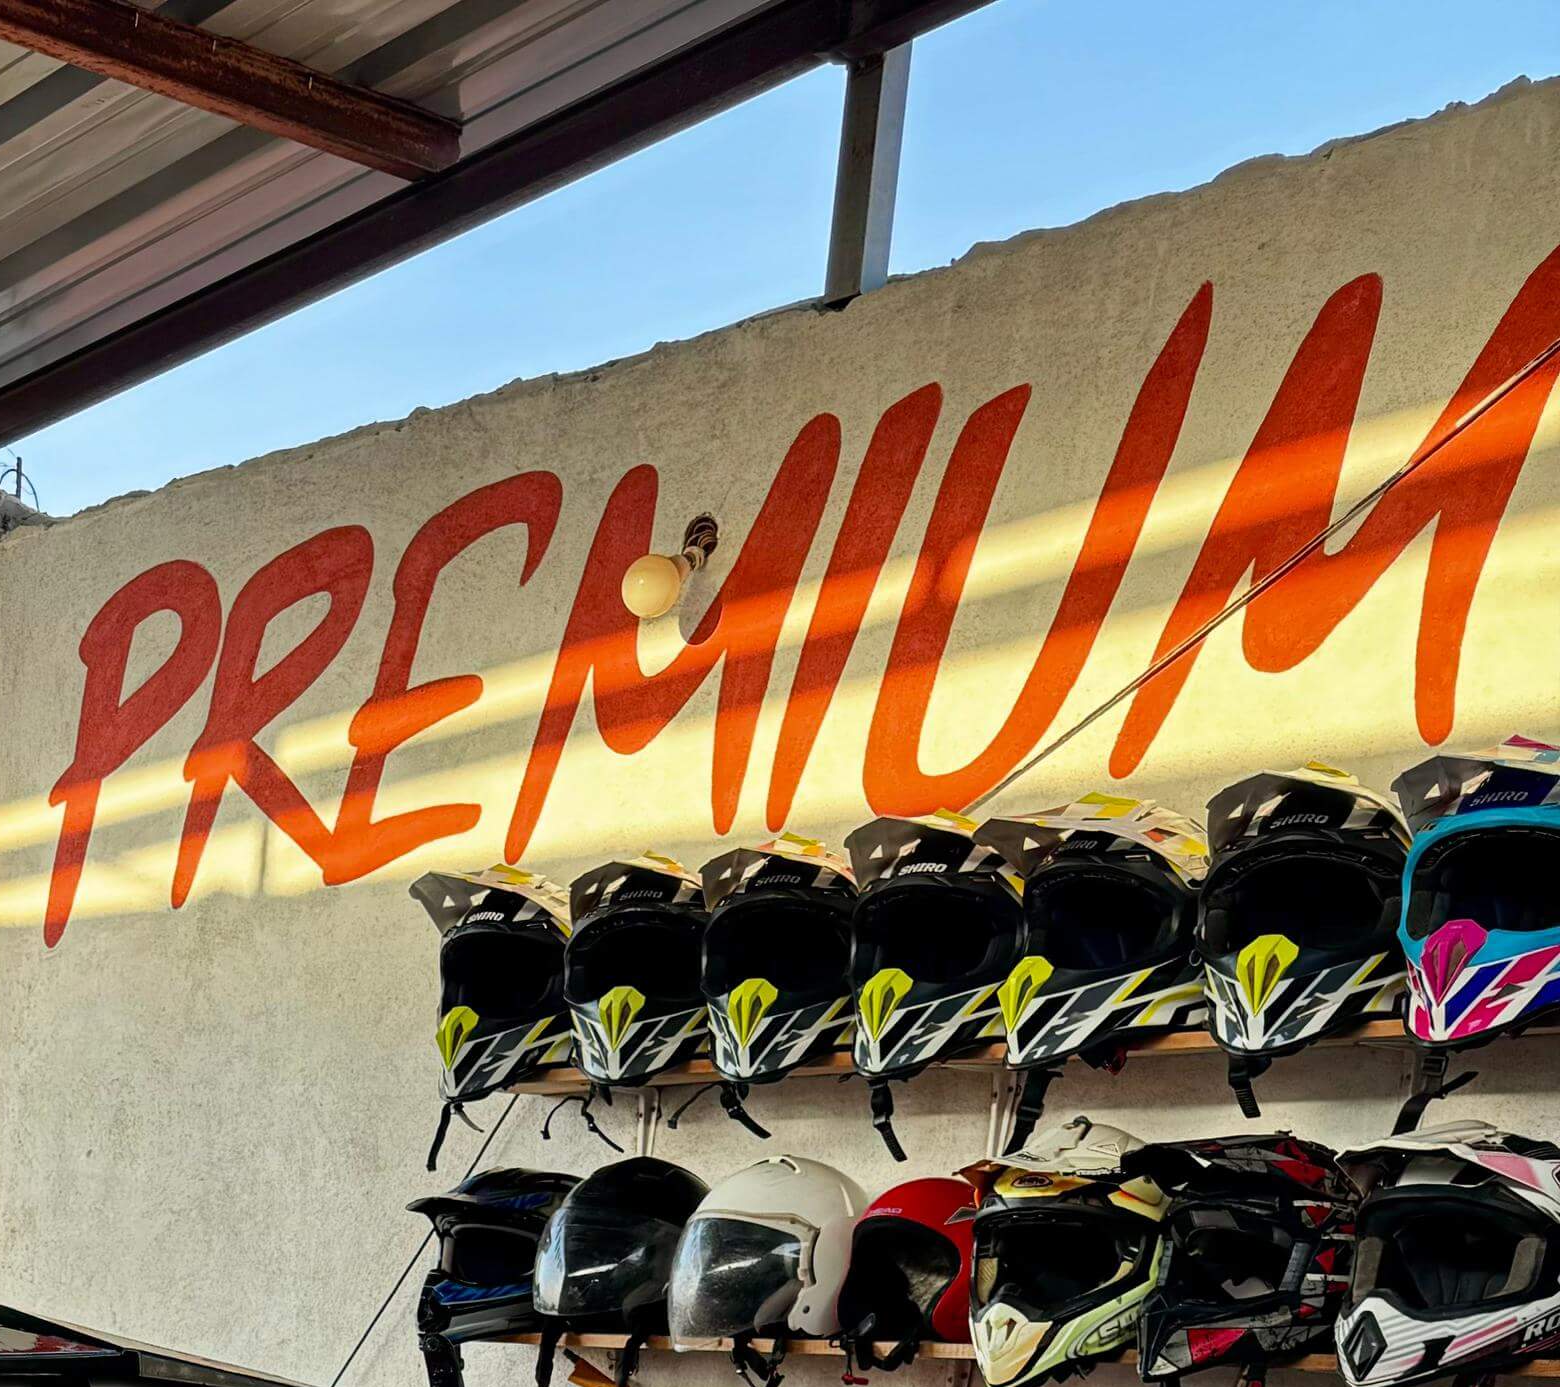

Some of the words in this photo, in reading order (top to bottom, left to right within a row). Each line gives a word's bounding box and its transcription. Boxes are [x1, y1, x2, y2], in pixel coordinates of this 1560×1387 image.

[43, 243, 1560, 948] PREMIUM
[1469, 790, 1530, 808] SHIRO
[1269, 812, 1331, 830] SHIRO
[897, 861, 948, 877] SHIRO
[755, 874, 801, 887] SHIRO
[619, 888, 663, 902] SHIRO
[466, 910, 505, 924] SHIRO
